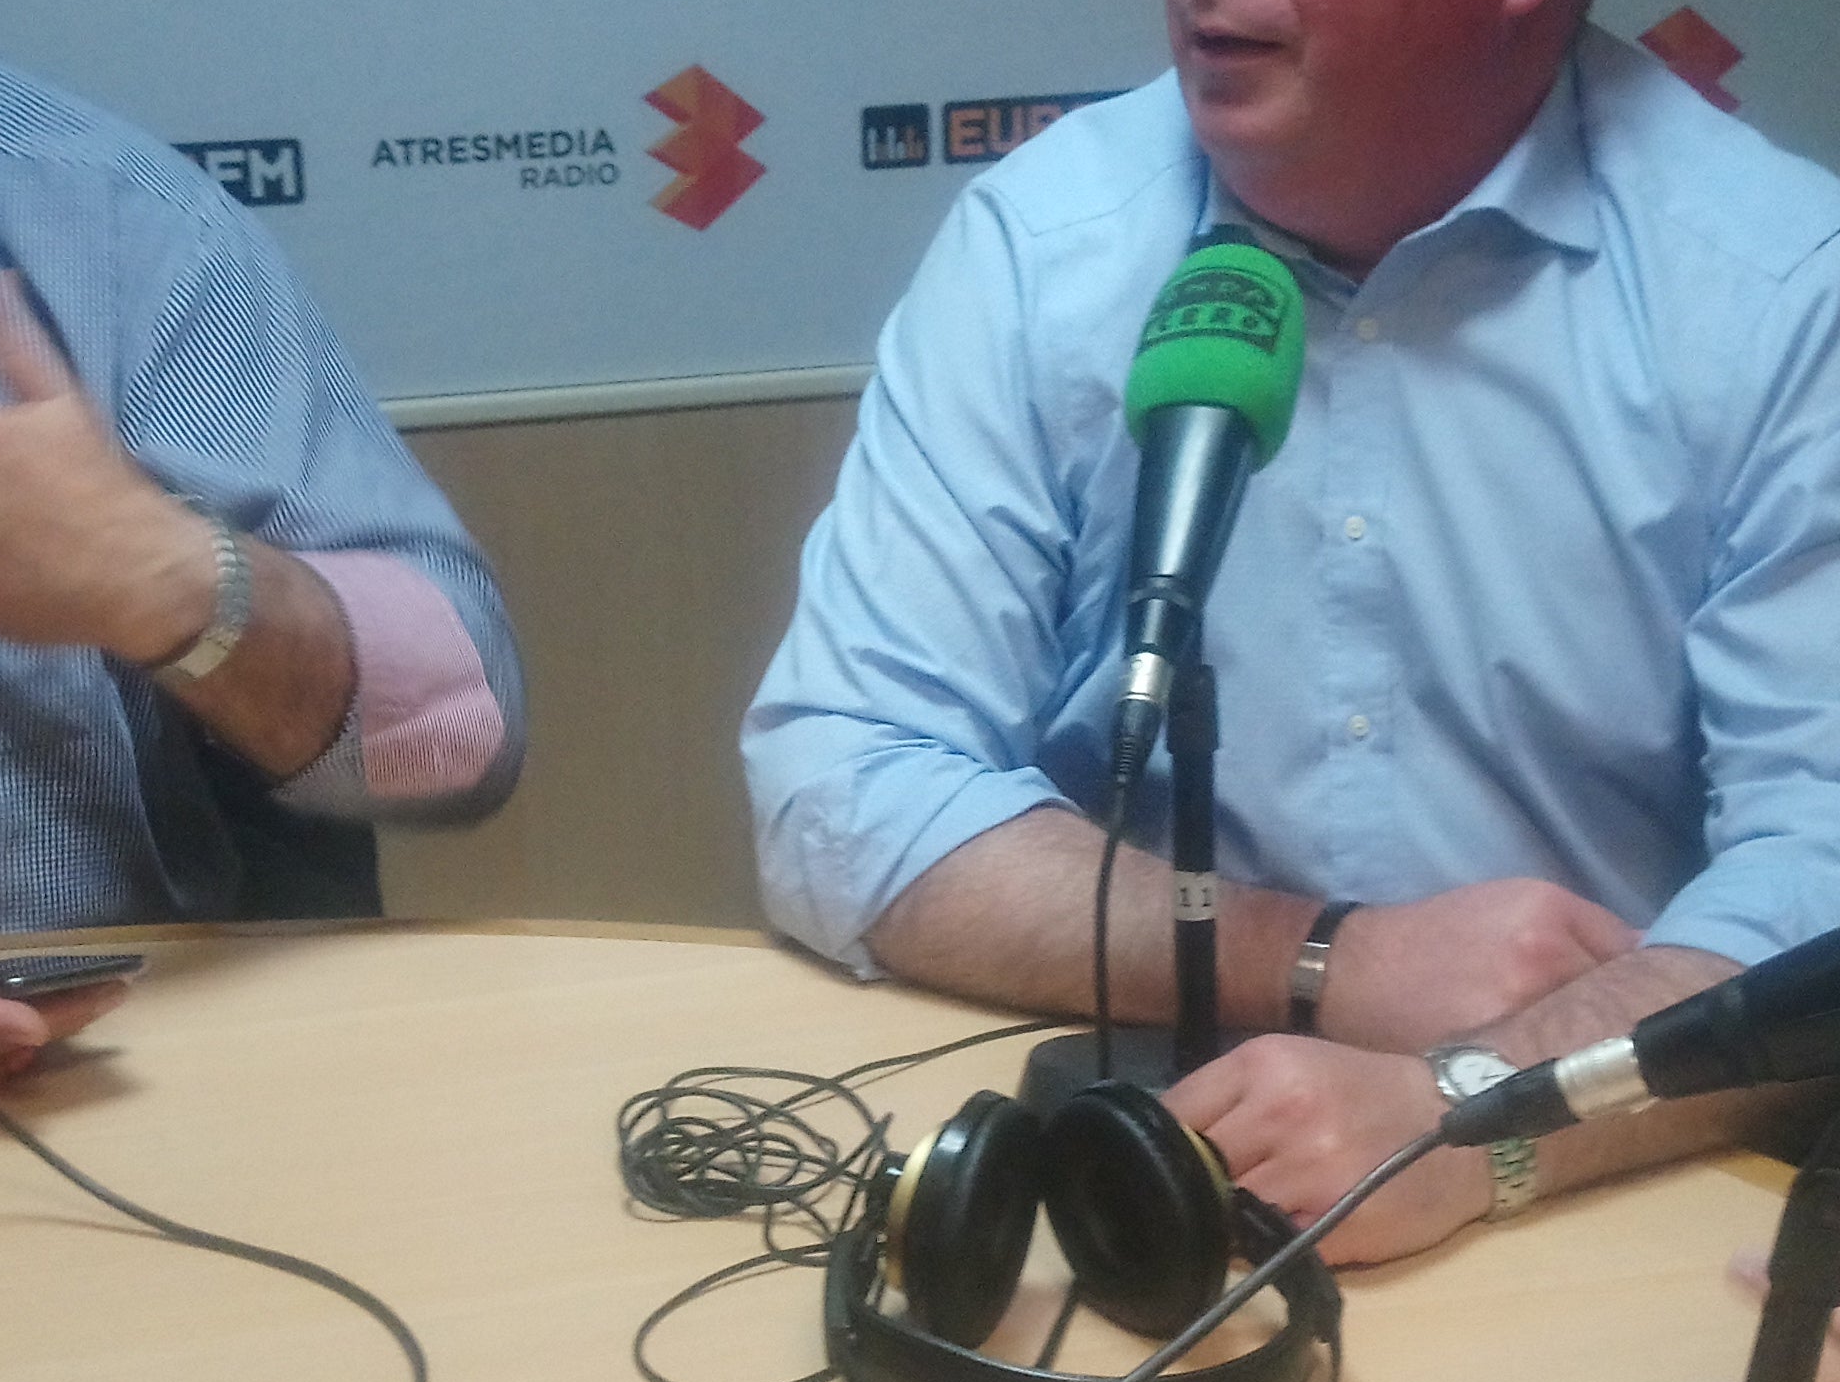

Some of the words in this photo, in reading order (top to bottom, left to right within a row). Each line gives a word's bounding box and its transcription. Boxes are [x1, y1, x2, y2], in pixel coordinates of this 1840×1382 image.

[372, 128, 616, 168] ATRESMEDIA
[206, 139, 298, 201] FM
[520, 162, 619, 190] RADIO
